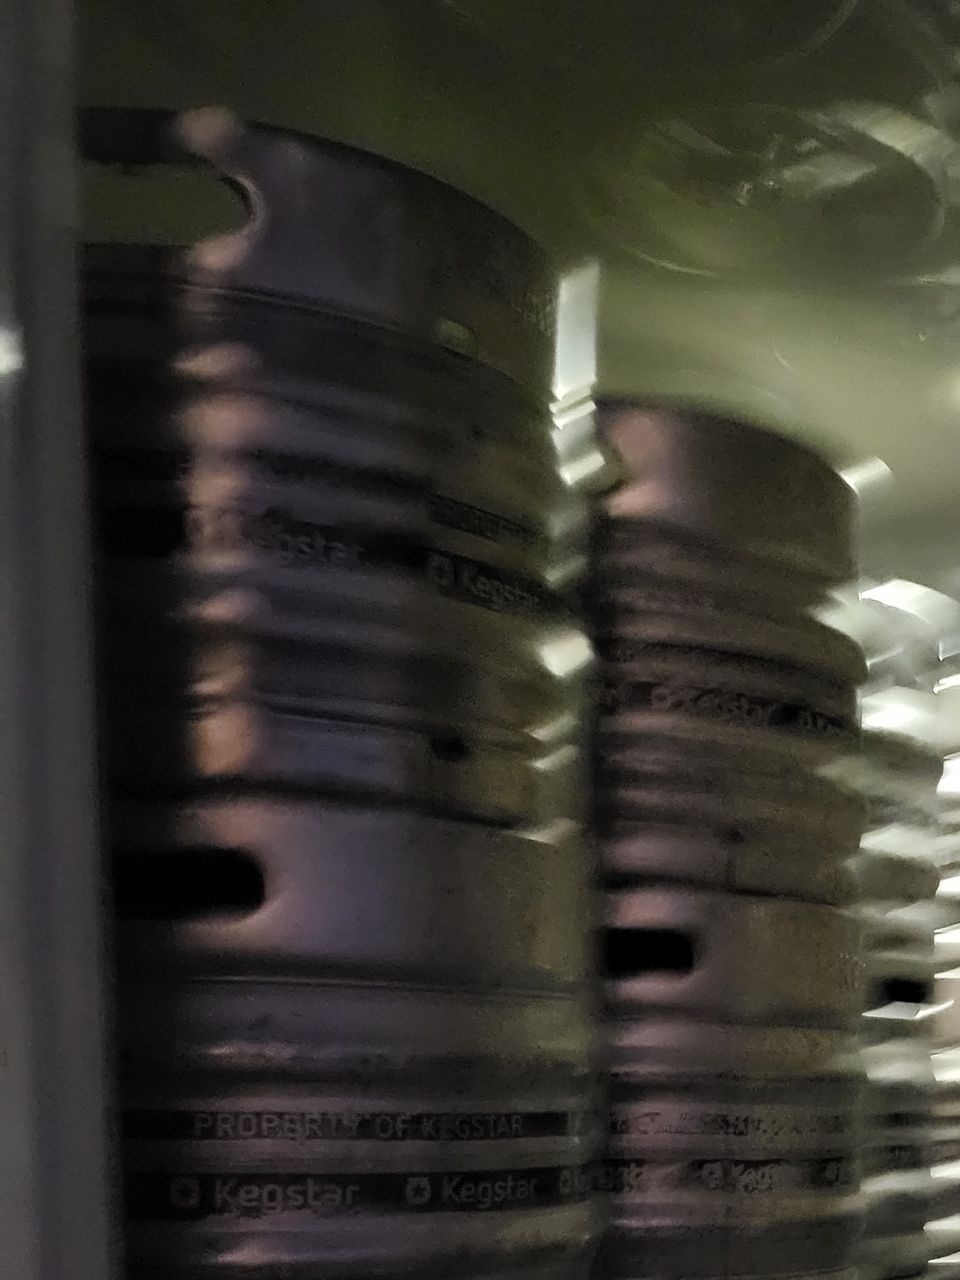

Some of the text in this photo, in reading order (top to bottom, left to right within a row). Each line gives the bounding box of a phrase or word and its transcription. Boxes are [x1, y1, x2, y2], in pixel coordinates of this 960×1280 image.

[193, 1110, 524, 1140] PROPERTY OF KEGSTAR
[214, 1175, 361, 1210] Kegstar
[441, 1173, 543, 1209] Kegstar
